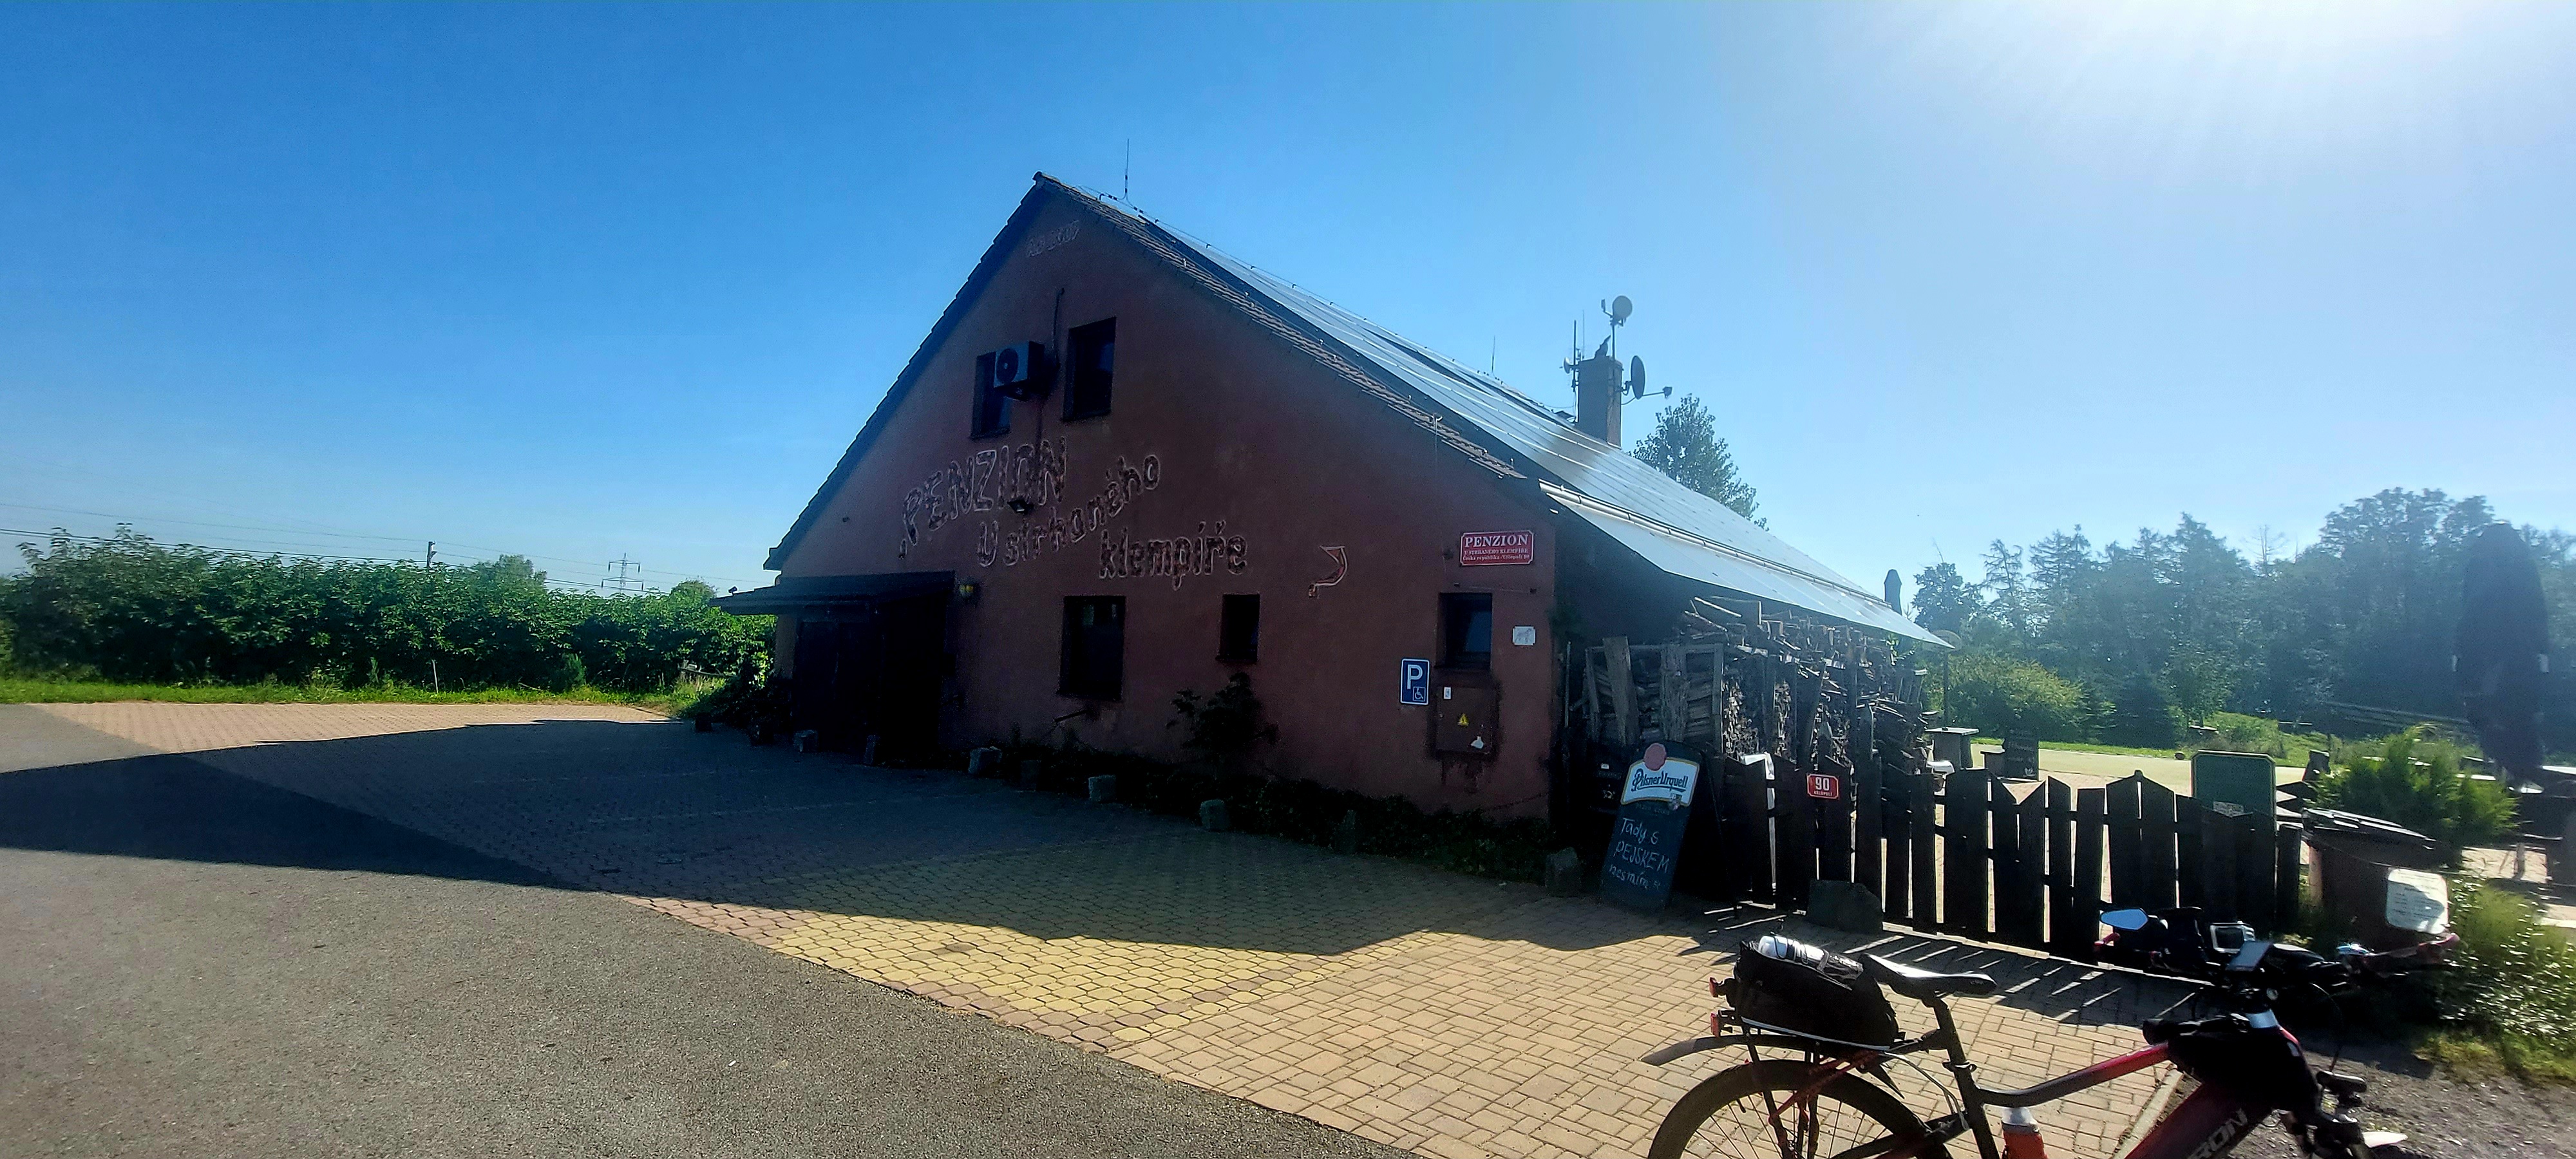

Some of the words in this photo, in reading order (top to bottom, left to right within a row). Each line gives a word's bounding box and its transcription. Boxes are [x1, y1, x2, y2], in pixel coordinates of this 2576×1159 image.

[902, 436, 1068, 546] PENZION
[1464, 534, 1529, 548] PENZION
[1099, 520, 1248, 591] klempíře
[1406, 664, 1423, 690] P
[1631, 768, 1661, 792] Pilsner
[1660, 771, 1689, 791] Urquell
[1815, 777, 1830, 791] 90
[1620, 817, 1647, 844] Tady
[1613, 840, 1670, 873] PEJSKEM
